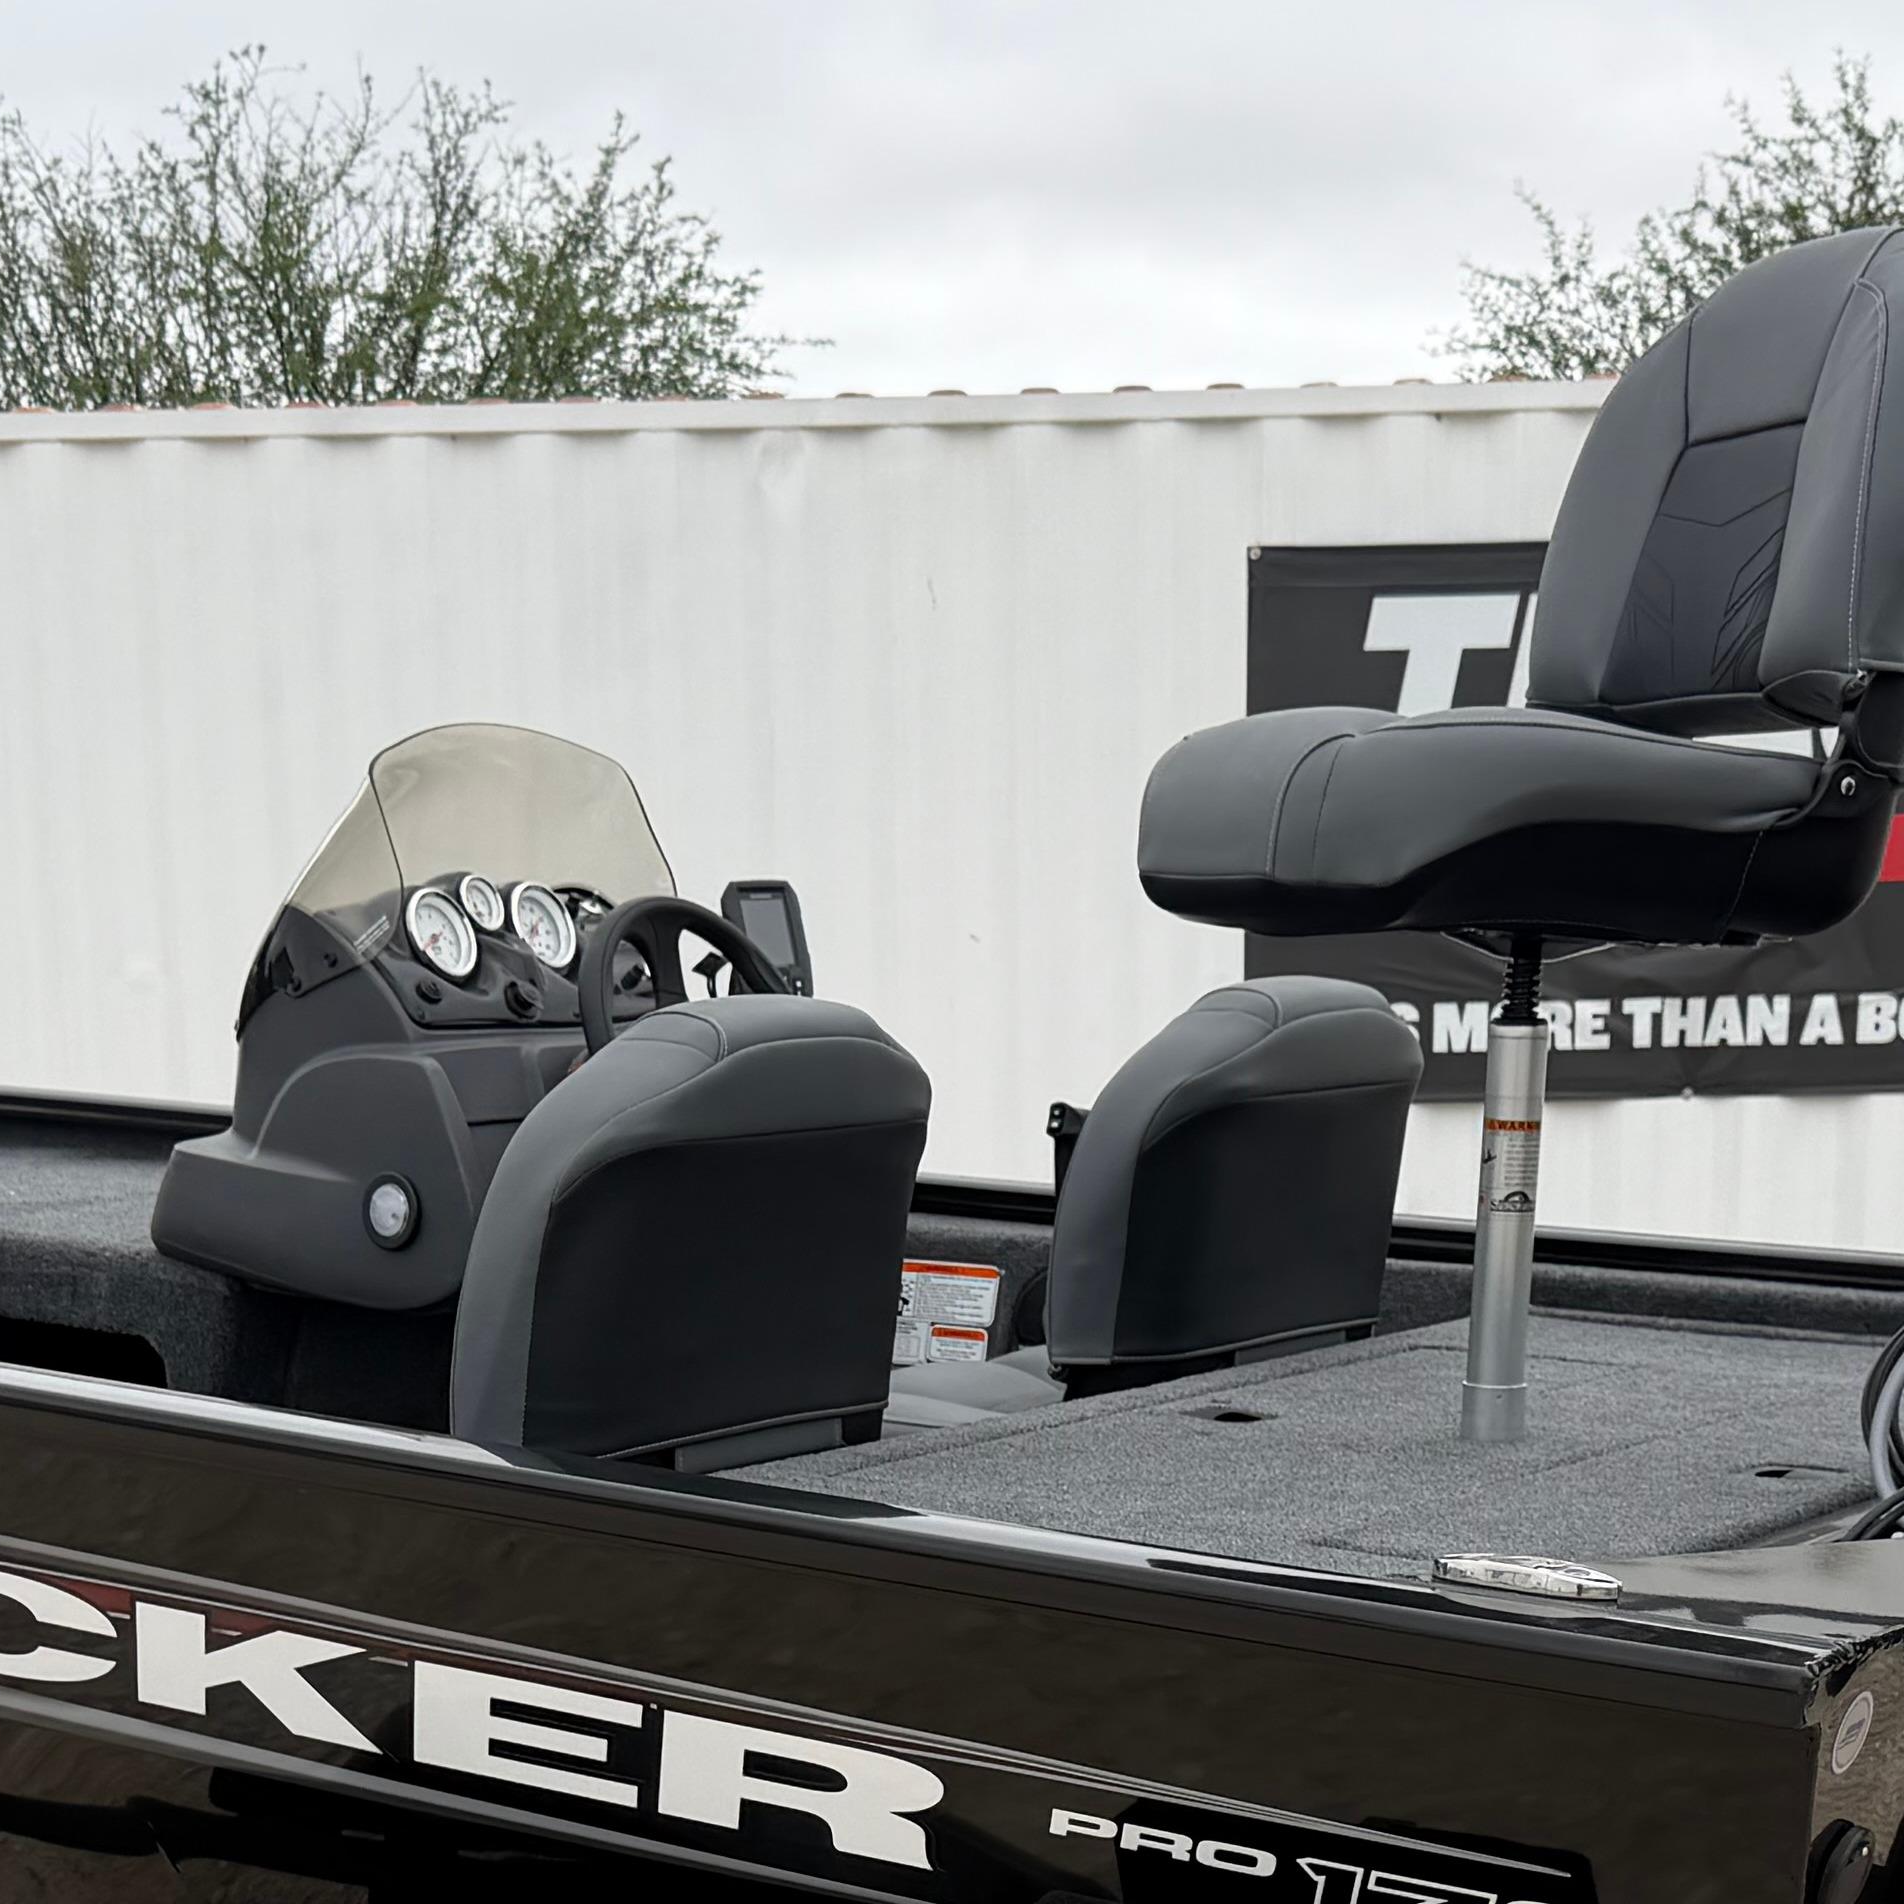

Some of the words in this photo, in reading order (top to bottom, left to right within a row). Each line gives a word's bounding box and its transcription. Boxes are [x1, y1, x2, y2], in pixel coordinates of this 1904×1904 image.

[1432, 999, 1612, 1054] MRE
[1622, 994, 1791, 1049] THAN
[1799, 993, 1844, 1046] A
[1049, 1808, 1277, 1877] PRO
